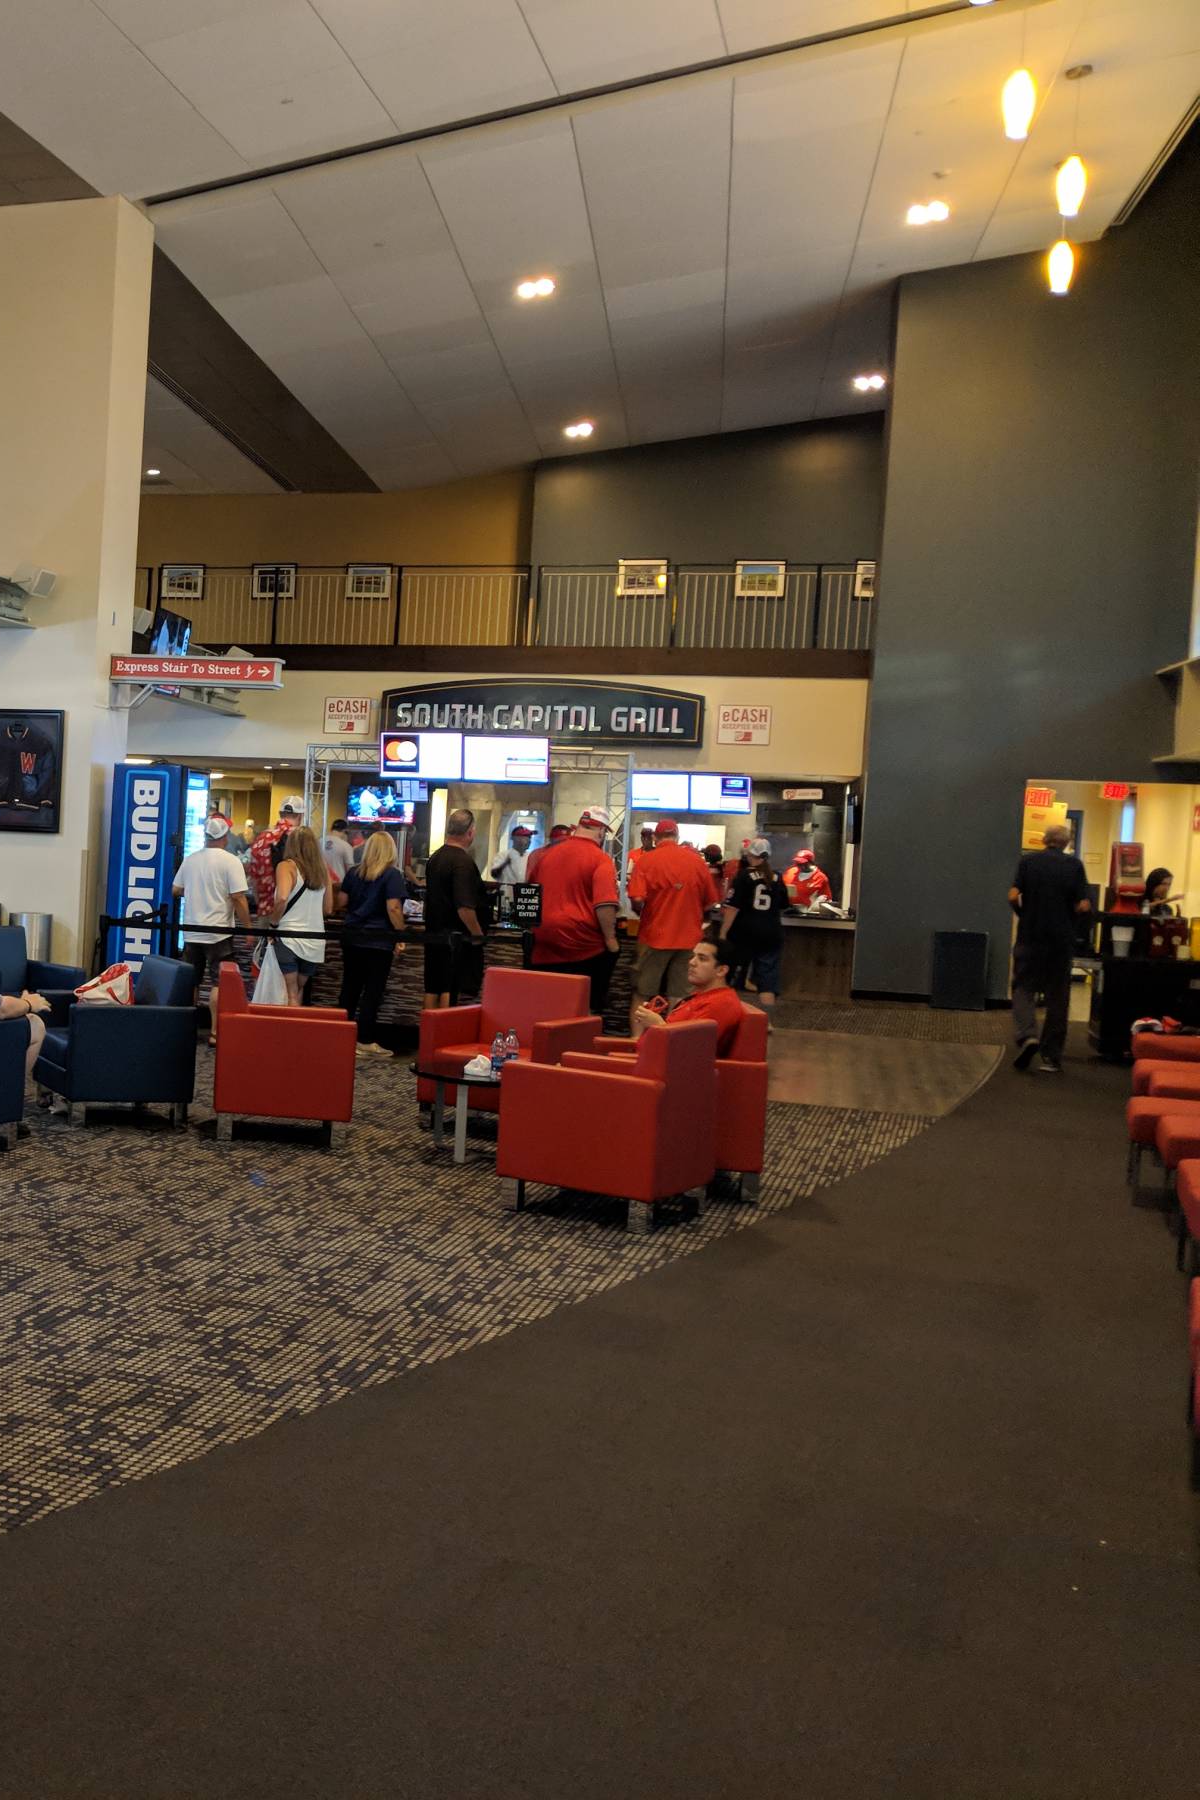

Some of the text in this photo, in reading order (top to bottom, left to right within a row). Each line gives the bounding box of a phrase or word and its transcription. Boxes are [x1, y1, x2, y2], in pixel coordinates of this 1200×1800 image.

[115, 661, 241, 675] Express Stair To Street
[328, 700, 368, 713] eCASH
[722, 708, 768, 723] eCASH
[396, 703, 685, 733] SOUTH CAPITOL GRILL
[21, 752, 36, 774] W
[131, 780, 160, 861] BUD
[753, 884, 771, 910] 6
